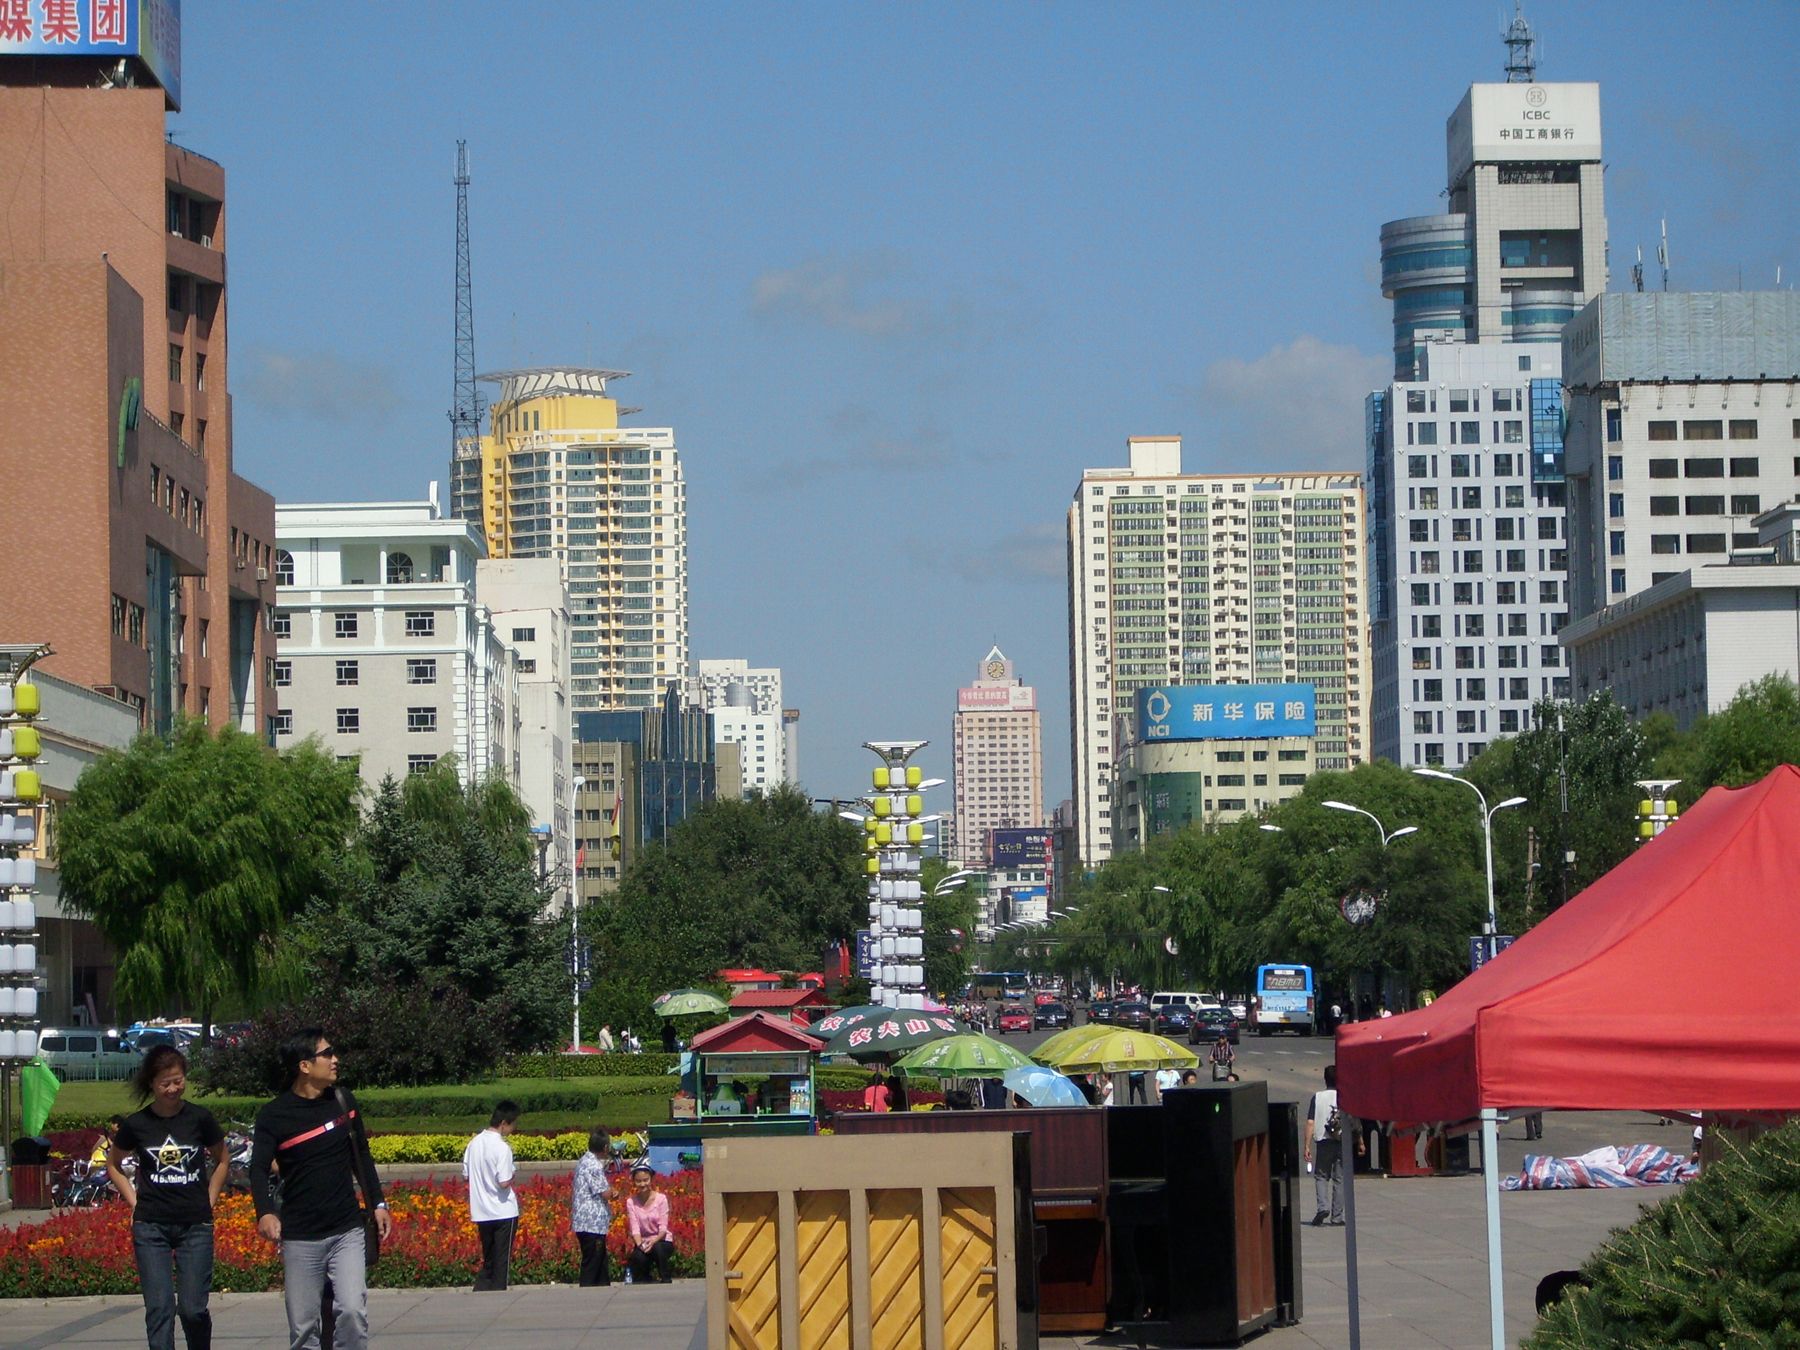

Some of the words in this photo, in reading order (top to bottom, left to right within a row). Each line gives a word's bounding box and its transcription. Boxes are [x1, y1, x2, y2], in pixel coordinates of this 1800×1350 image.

[1522, 110, 1551, 121] ICBC
[1499, 128, 1575, 140] 中国工商银行
[1192, 701, 1306, 722] 新华保险
[1147, 725, 1170, 737] NCI
